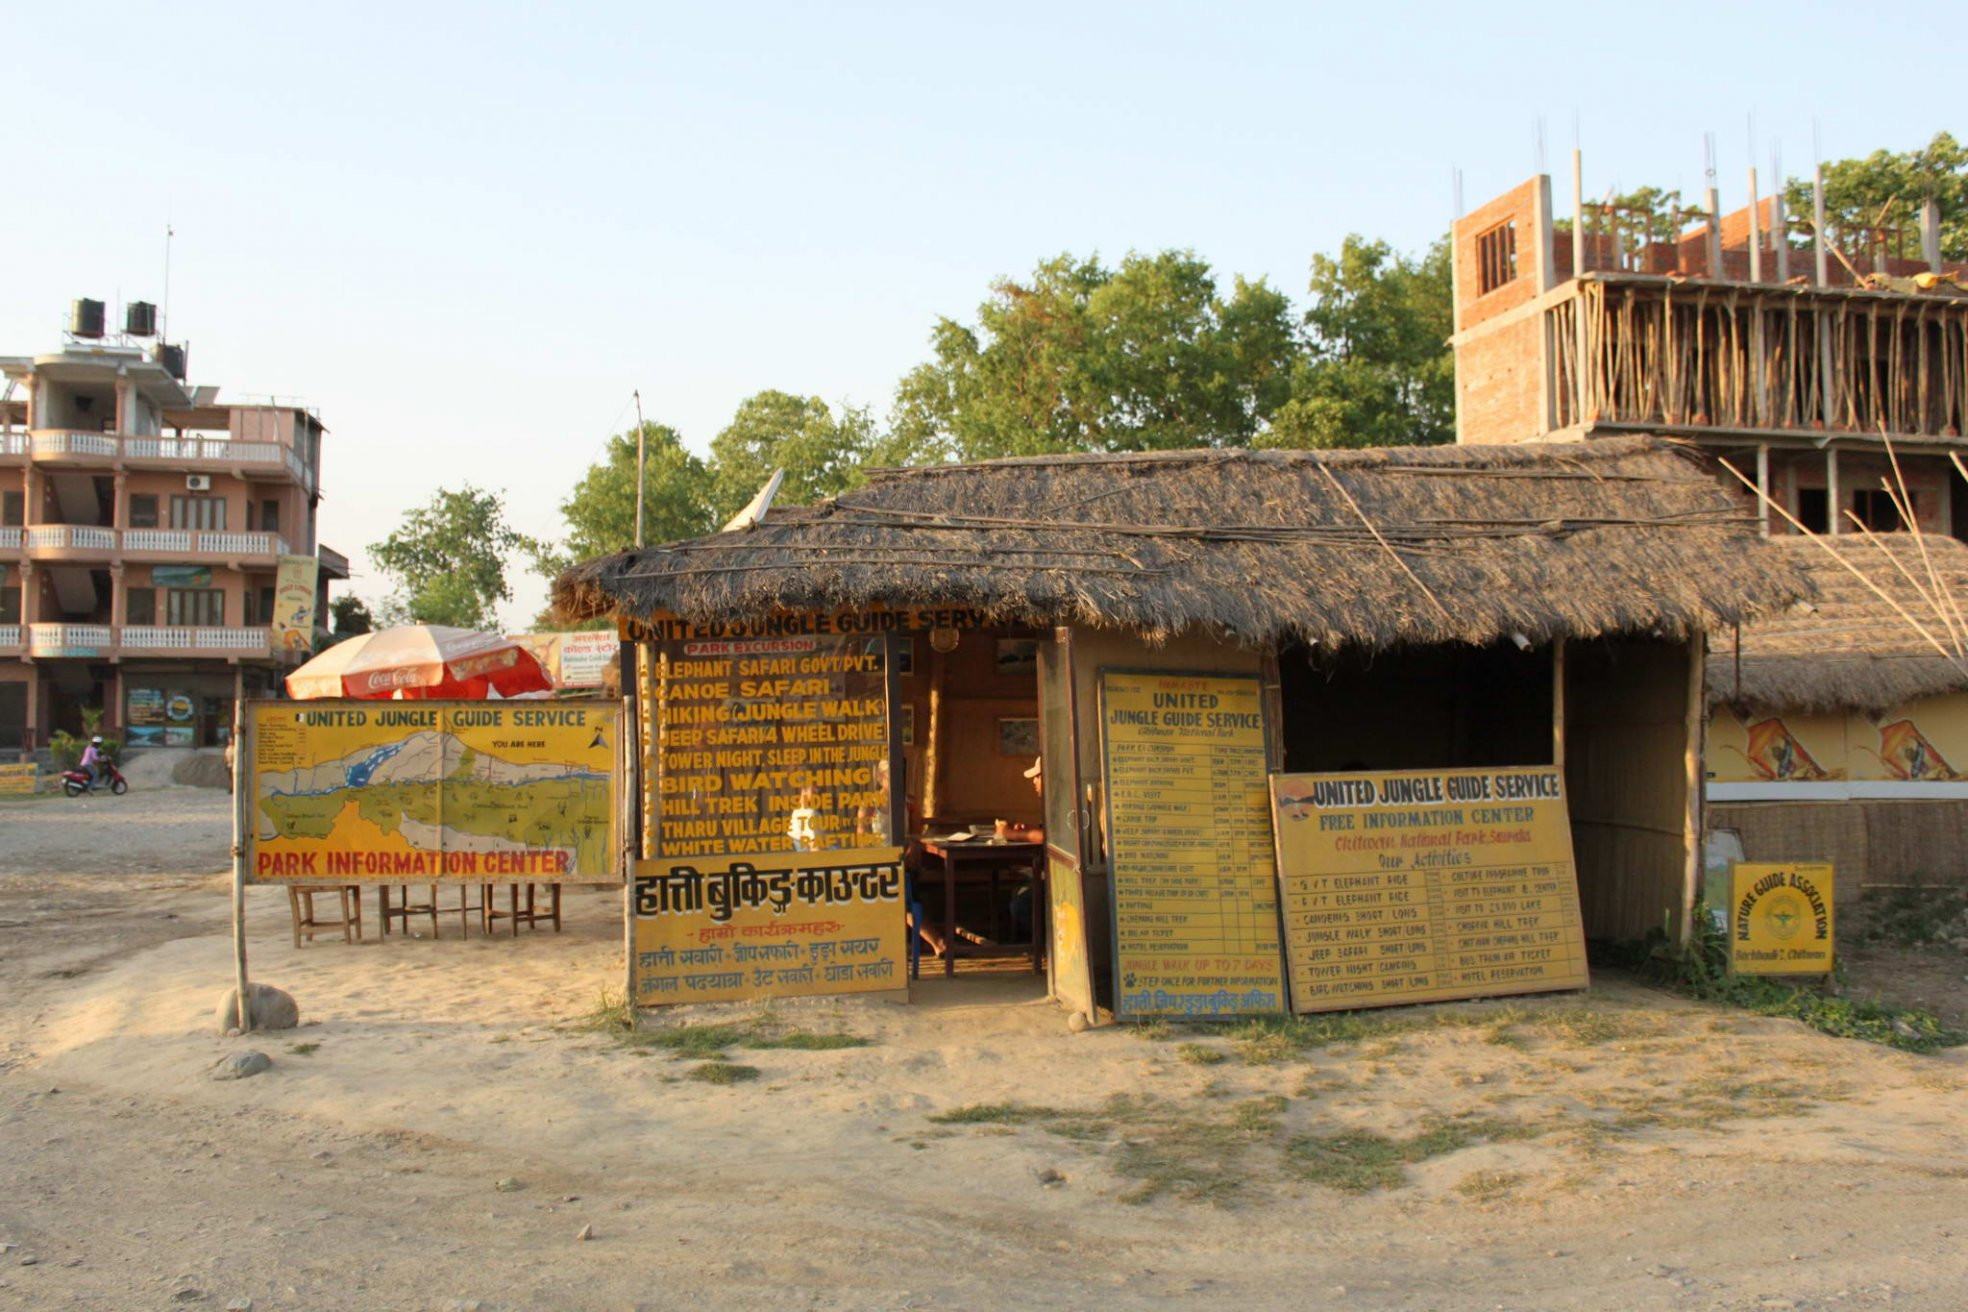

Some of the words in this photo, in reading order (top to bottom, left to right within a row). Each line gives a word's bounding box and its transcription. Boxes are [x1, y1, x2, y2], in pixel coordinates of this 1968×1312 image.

[836, 609, 909, 633] GUIDE
[686, 642, 730, 656] PARK
[734, 639, 815, 654] EXCURSION
[655, 659, 732, 679] ELEPHANT
[739, 657, 797, 677] SAFARI
[655, 682, 730, 701] CANOE
[741, 678, 830, 698] SAFARI
[1153, 692, 1219, 710] UNITED
[306, 709, 367, 728] UNITED
[375, 709, 438, 727] JUNGLE
[453, 709, 503, 727] GUIDE
[513, 709, 586, 727] SERVICE
[657, 705, 728, 726] HIKING
[1110, 709, 1158, 727] JUNGLE
[1163, 711, 1202, 728] GUIDE
[1207, 713, 1261, 730] SERVICE
[492, 740, 508, 749] YOU
[511, 740, 525, 749] ARE
[527, 740, 545, 749] HERE
[659, 728, 702, 747] JEEP
[782, 724, 835, 743] WHEEL
[661, 750, 712, 770] TOWER
[767, 746, 807, 766] SLEEP
[810, 745, 823, 762] IN
[823, 745, 841, 762] THE
[661, 774, 722, 796] BIRD
[730, 767, 872, 791] WATCHING
[1314, 780, 1376, 807] UNITED
[1380, 777, 1443, 805] JUNGLE
[1447, 776, 1491, 801] GUIDE
[1496, 773, 1560, 799] SERVICE
[661, 798, 701, 817] HILL
[705, 796, 757, 815] TREK
[768, 793, 832, 812] INSIDE
[838, 789, 889, 808] PARK
[662, 818, 717, 839] THARU
[722, 816, 791, 837] VILLAGE
[797, 814, 839, 833] TOUR
[1320, 814, 1354, 831] FREE
[1363, 808, 1463, 829] INFORMATION
[1472, 806, 1534, 824] CENTER
[661, 837, 732, 856] WHITE
[736, 835, 795, 853] WATER
[1401, 832, 1451, 848] National
[1455, 830, 1487, 845] Park
[257, 851, 318, 876] PARK
[327, 850, 484, 875] INFORMATION
[488, 850, 569, 873] CENTER
[1379, 854, 1404, 869] Our
[1411, 849, 1472, 869] Activities
[1334, 876, 1380, 889] ELEPHANT
[1336, 892, 1382, 906] ELEPHANT
[1737, 891, 1758, 941] NATURE
[1753, 872, 1786, 896] GUIDE
[1306, 929, 1340, 943] JUNGLE
[1195, 959, 1210, 970] UP
[1244, 960, 1274, 971] DAYS
[1309, 948, 1331, 961] JEEP
